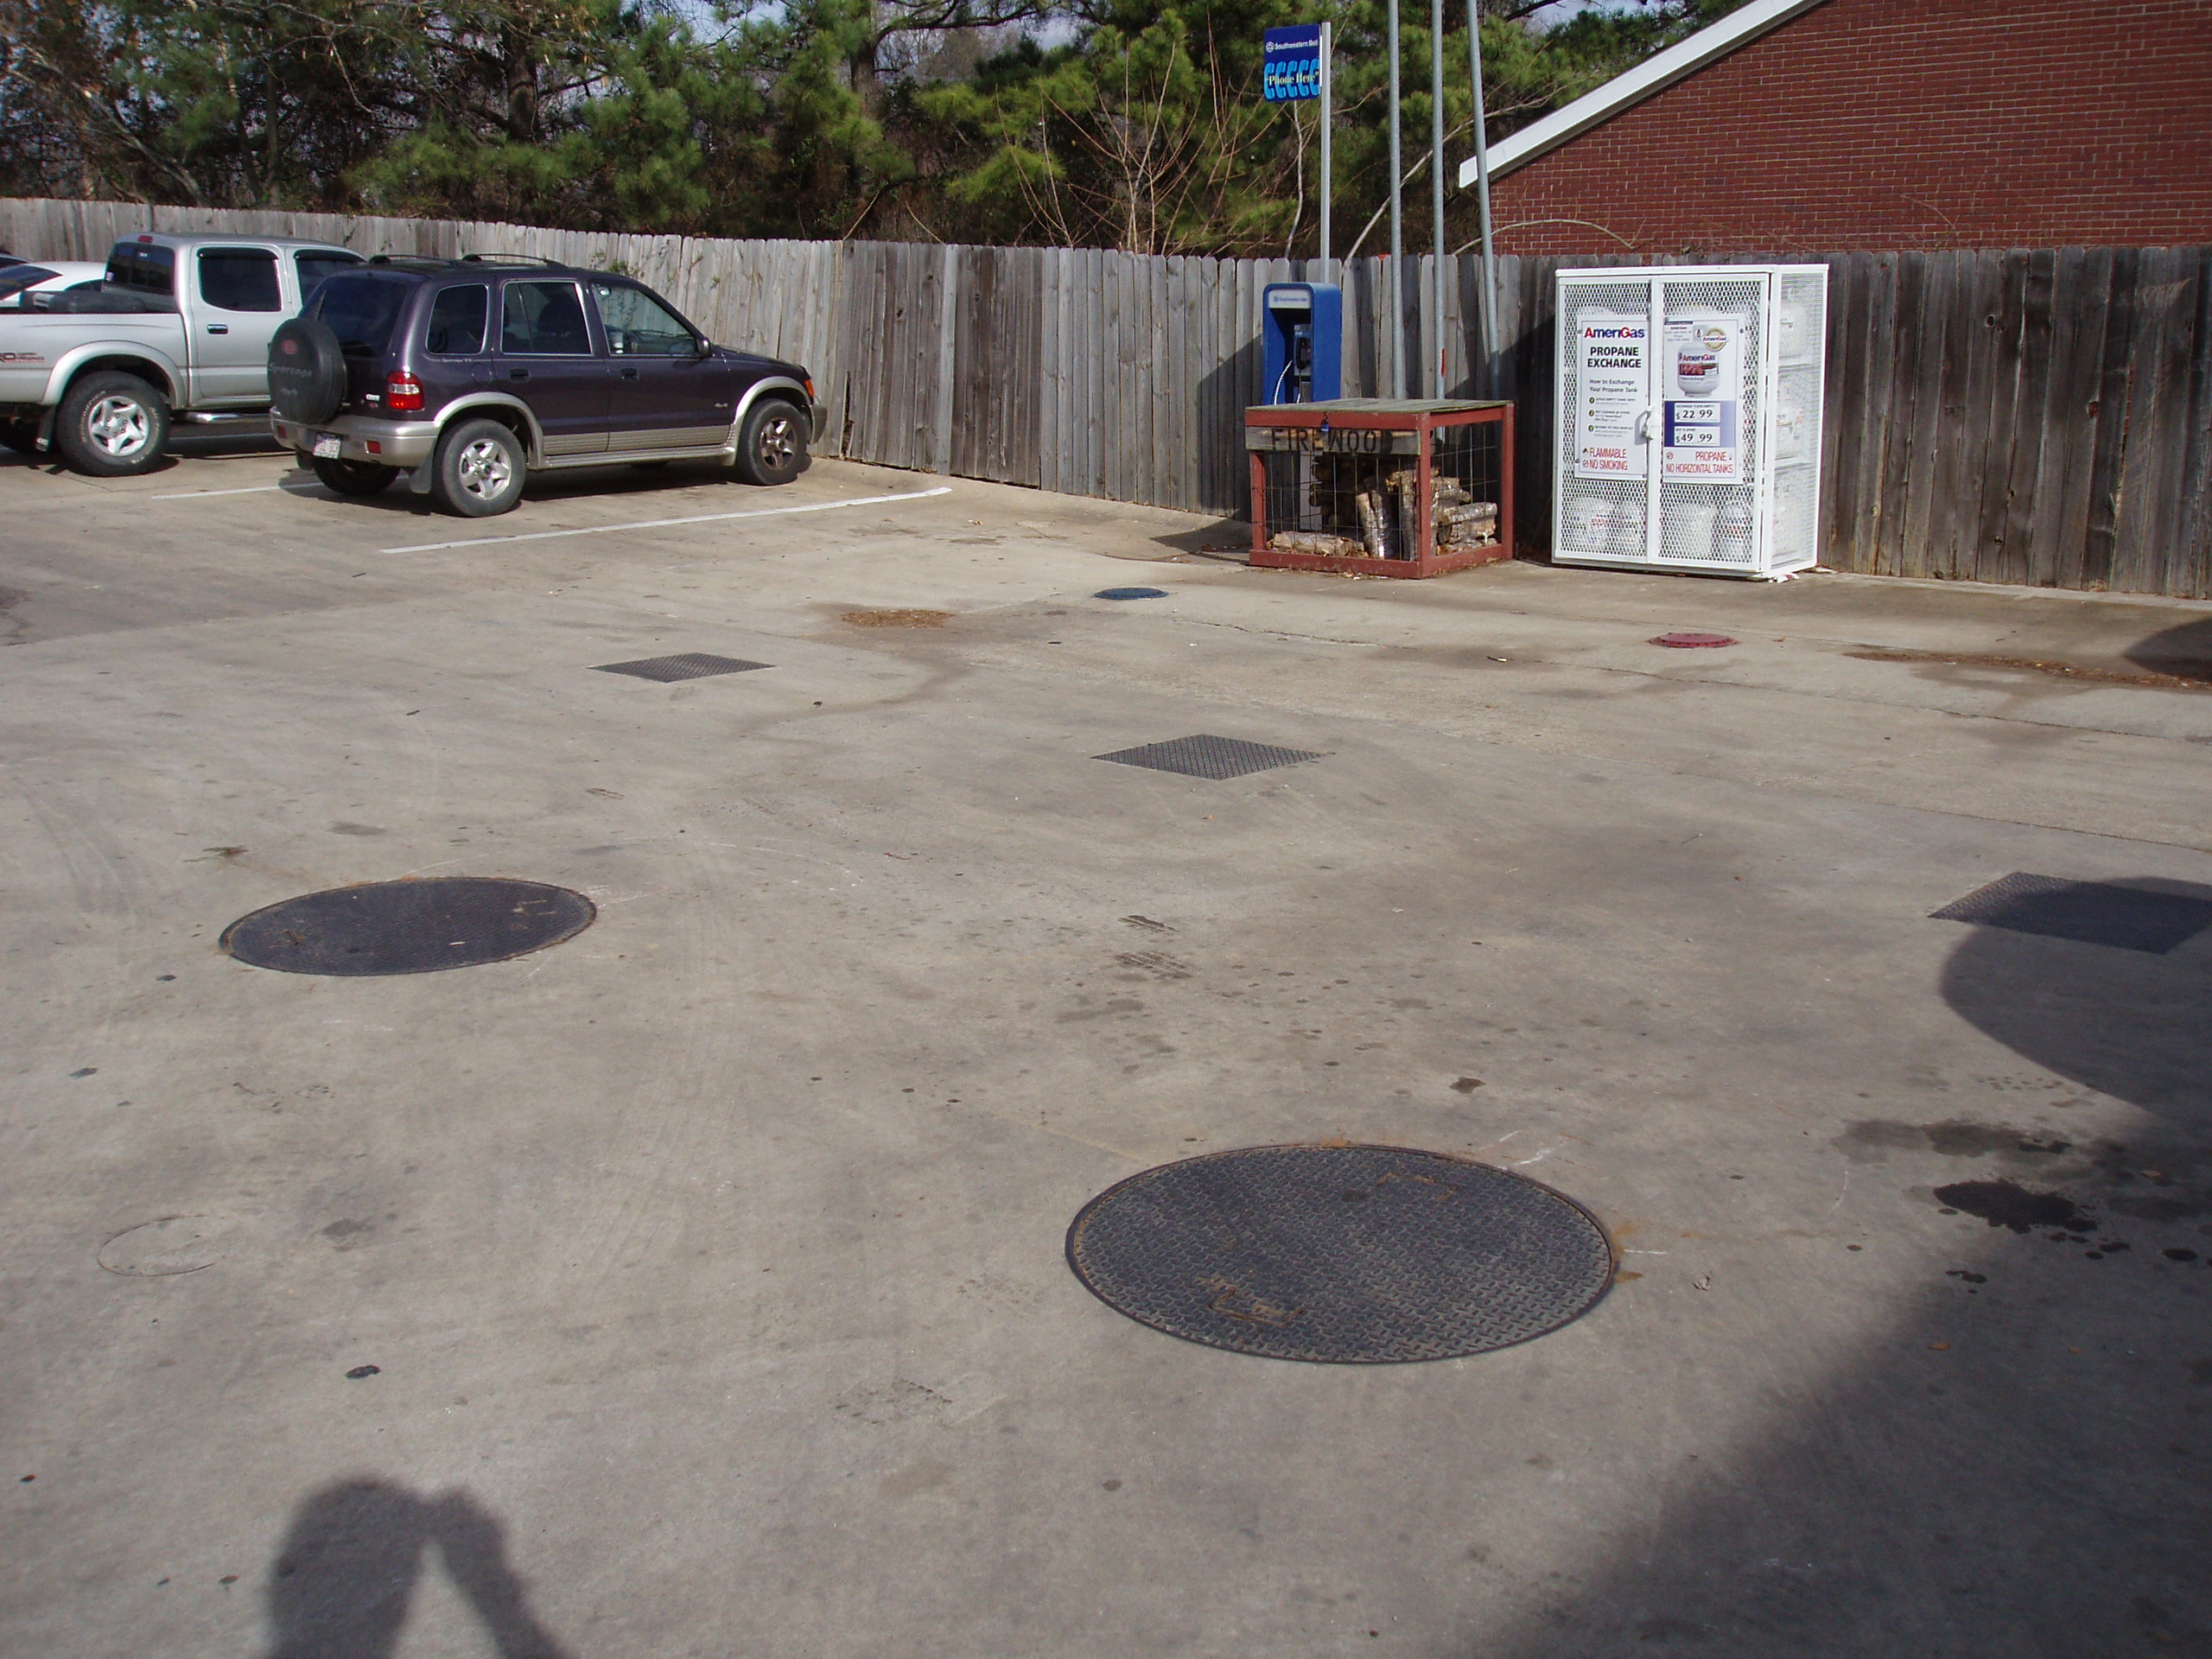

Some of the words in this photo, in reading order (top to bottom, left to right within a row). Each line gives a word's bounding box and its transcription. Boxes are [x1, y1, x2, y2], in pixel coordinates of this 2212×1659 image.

[1584, 327, 1645, 338] AmeriGas
[1590, 346, 1639, 356] PROPANE
[1587, 359, 1642, 368] EXCHANGE
[1590, 448, 1627, 458] FLAMMABLE
[1695, 451, 1727, 461] PROPANE
[1590, 460, 1598, 469] NO
[1599, 460, 1628, 470] SMOKING
[1666, 463, 1675, 473] NO
[1675, 463, 1713, 473] HORIZONTAL
[1713, 464, 1733, 474] TANKS
